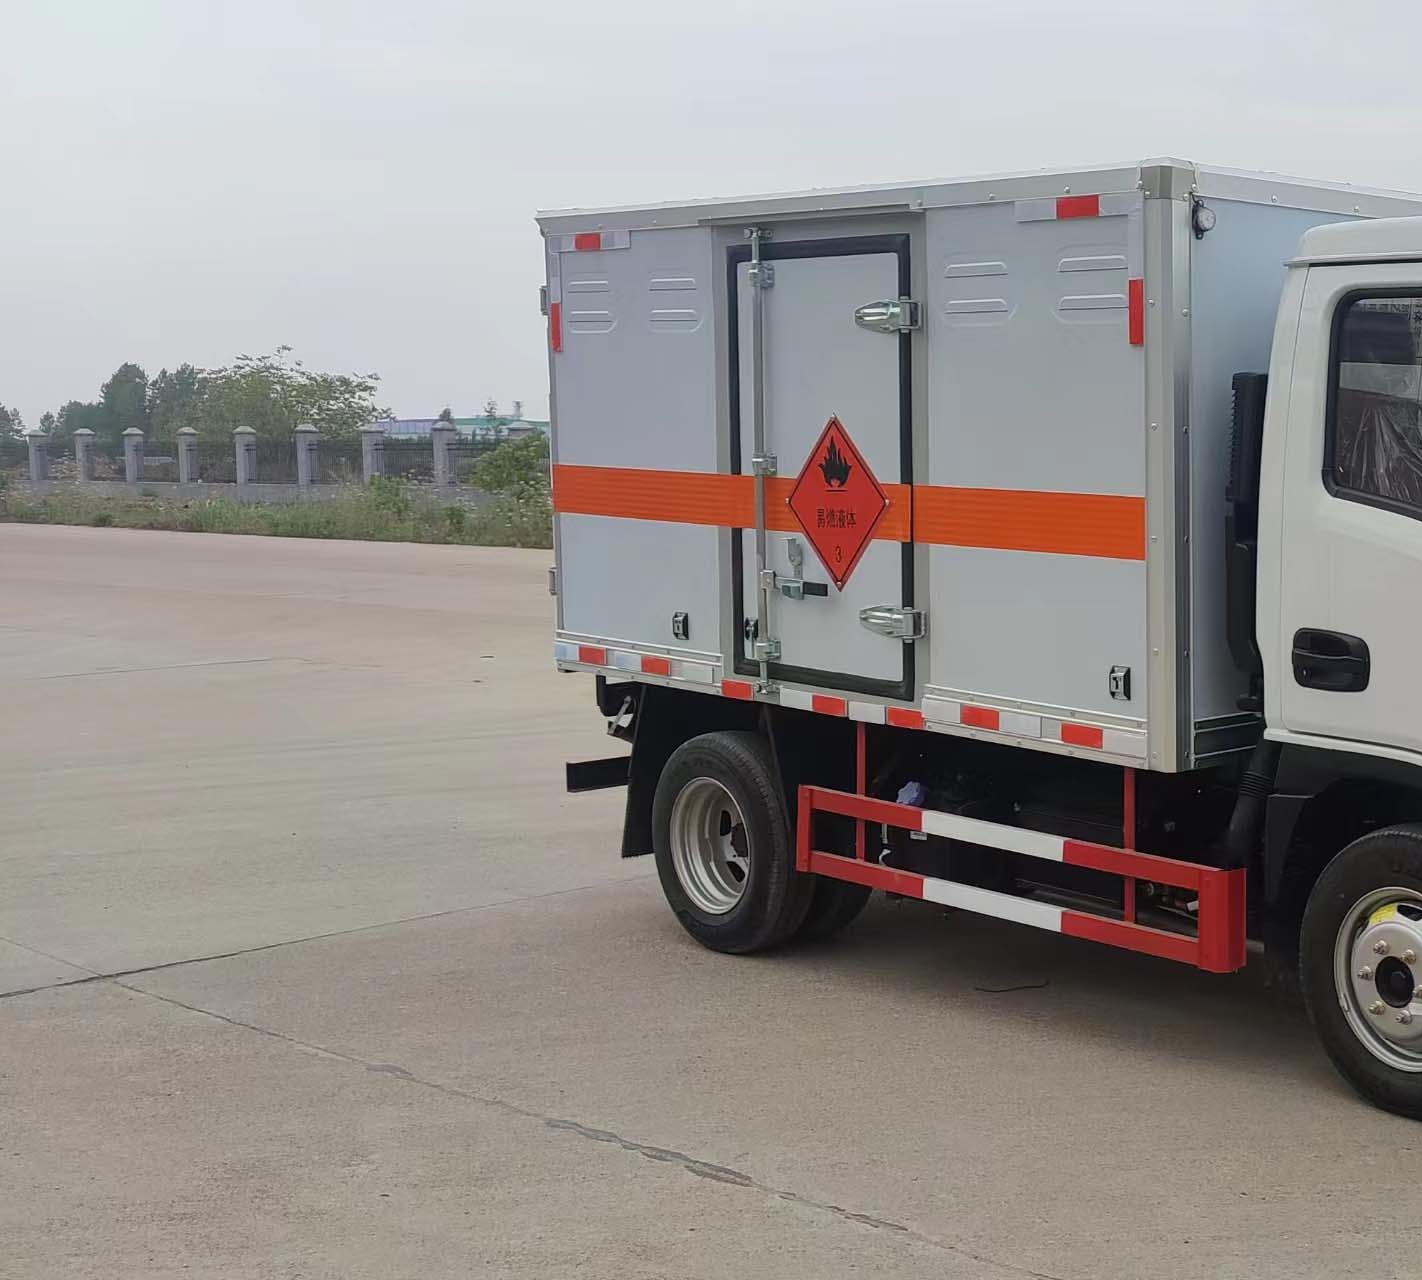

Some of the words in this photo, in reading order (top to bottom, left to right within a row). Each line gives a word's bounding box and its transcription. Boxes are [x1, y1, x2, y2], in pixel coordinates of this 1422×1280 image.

[817, 508, 856, 528] 易燃液体
[835, 546, 842, 563] 3
